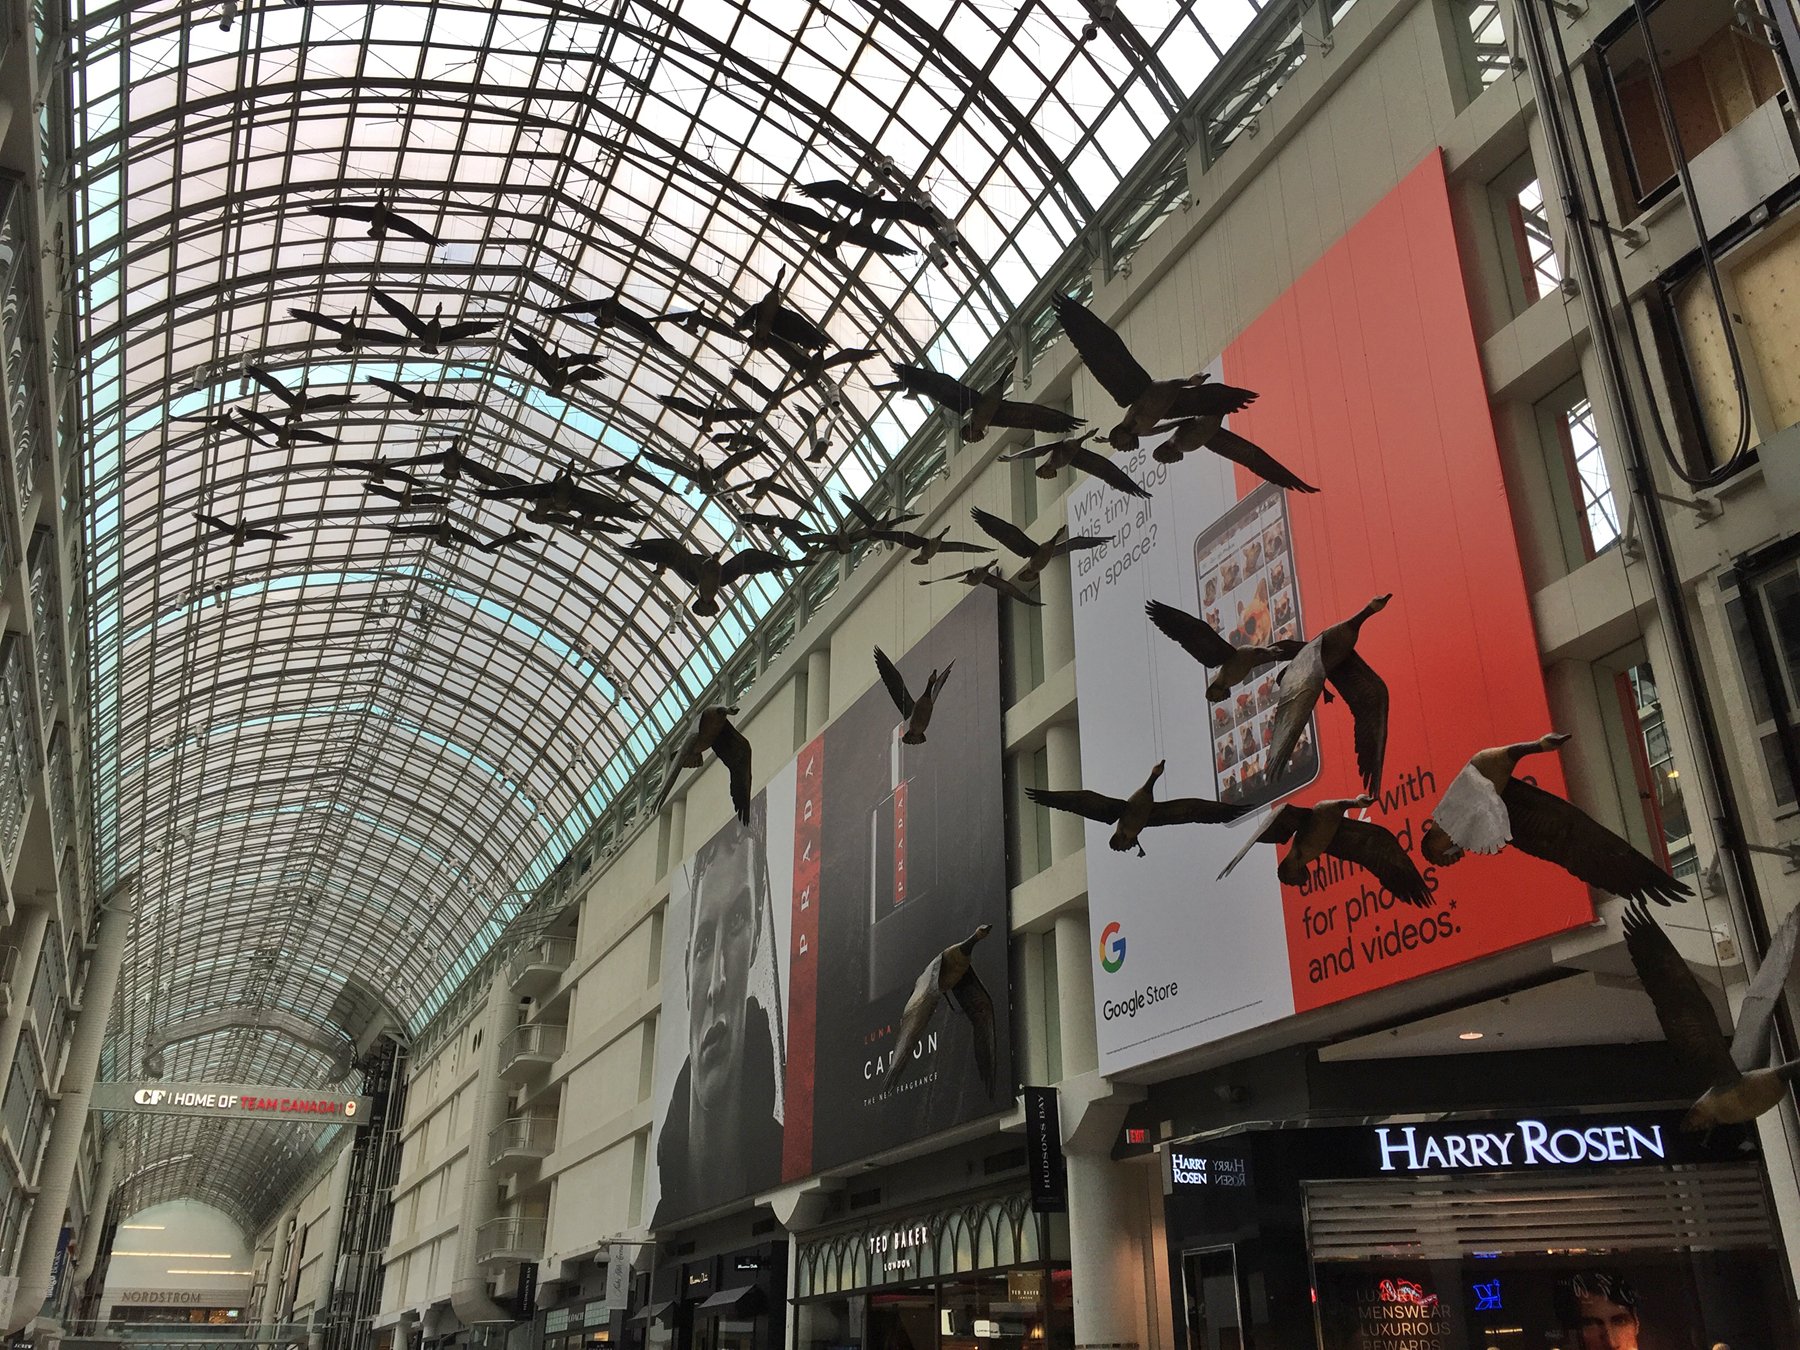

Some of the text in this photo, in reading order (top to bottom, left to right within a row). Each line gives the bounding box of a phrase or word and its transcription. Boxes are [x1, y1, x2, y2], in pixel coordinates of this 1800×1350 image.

[1074, 484, 1105, 522] Why
[1105, 494, 1130, 524] tiny
[1138, 462, 1167, 499] dog
[1078, 498, 1152, 577] take up all
[1080, 523, 1158, 607] my space?
[1377, 766, 1436, 815] with
[799, 755, 815, 957] PRADA
[1302, 866, 1440, 940] for phos
[1308, 936, 1355, 984] and
[1103, 982, 1178, 1020] Google Store
[864, 1025, 892, 1046] LUNA
[174, 1092, 215, 1108] HOME
[217, 1095, 238, 1109] OF
[240, 1096, 278, 1112] TEAM
[280, 1098, 337, 1114] CANADA
[864, 1096, 876, 1107] THE
[896, 1071, 938, 1095] FRAGRANCE
[1038, 1094, 1046, 1119] BAY
[1130, 1129, 1145, 1143] EXIT
[1375, 1120, 1665, 1170] HARRY ROSEN
[1172, 1154, 1207, 1170] HARRY
[1173, 1168, 1208, 1184] ROSEN
[870, 1226, 927, 1255] TED BAKER
[884, 1259, 911, 1271] LONDON
[121, 1291, 201, 1303] NORDSTROM
[1358, 1304, 1451, 1319] MENSWEAR
[1361, 1321, 1450, 1336] LUXURIOUS
